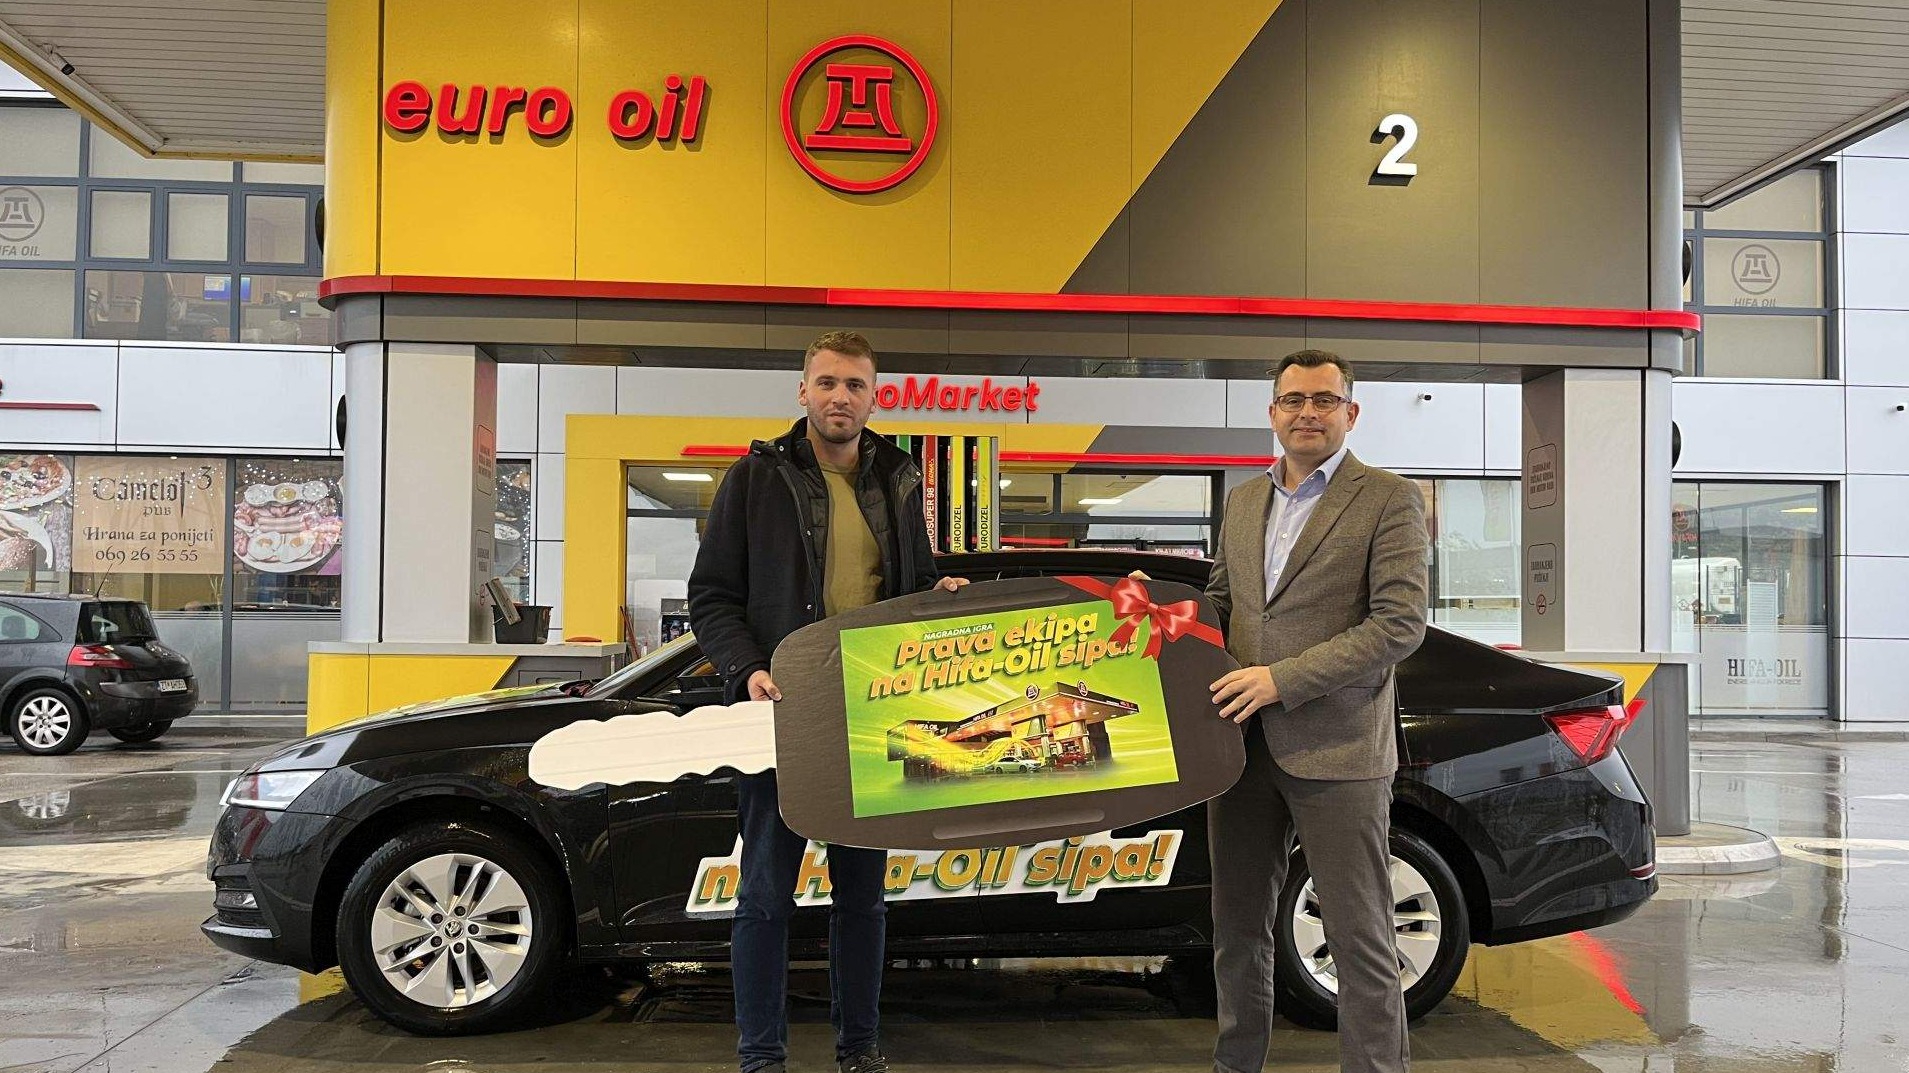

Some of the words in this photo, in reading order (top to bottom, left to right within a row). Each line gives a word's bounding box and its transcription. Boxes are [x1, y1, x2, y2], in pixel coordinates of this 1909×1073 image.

[384, 79, 573, 136] euro
[606, 72, 706, 142] oil
[1376, 112, 1418, 176] 2
[21, 245, 40, 257] OIL
[876, 375, 1041, 412] oMarket
[93, 471, 190, 519] Camelot
[197, 465, 213, 491] 3
[926, 487, 935, 498] 98
[83, 526, 135, 542] Hrana
[139, 531, 156, 542] za
[161, 526, 213, 545] ponijeti
[981, 505, 989, 549] URODIZEL
[95, 545, 126, 565] 069
[130, 548, 151, 562] 26
[157, 549, 176, 562] 55
[179, 549, 198, 562] 55
[896, 630, 998, 668] Prava
[1004, 612, 1099, 647] ekipa
[923, 627, 971, 640] NAGRADNA
[972, 622, 993, 634] IGRA
[869, 670, 916, 699] na
[922, 642, 1051, 690] Hifa-Oil
[697, 864, 742, 903] n
[794, 844, 1021, 897] Ha-Oil
[1027, 833, 1175, 893] sipa!
